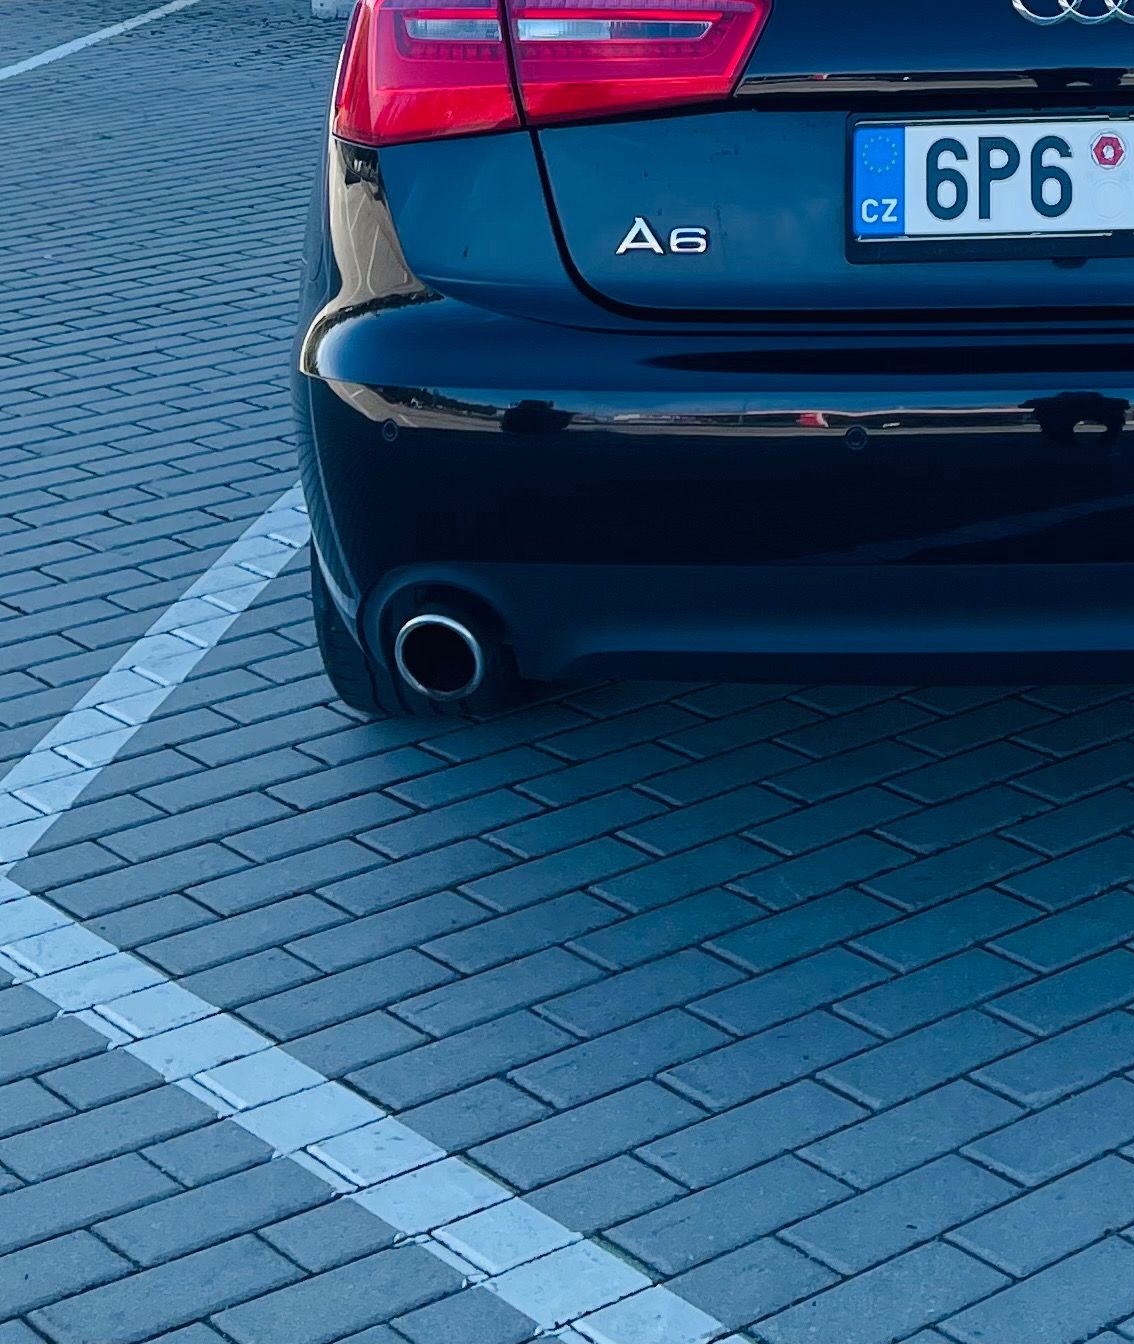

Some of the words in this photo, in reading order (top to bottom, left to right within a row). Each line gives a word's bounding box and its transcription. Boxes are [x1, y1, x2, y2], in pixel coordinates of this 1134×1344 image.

[925, 135, 1073, 221] 6P6
[861, 198, 898, 224] CZ
[615, 217, 707, 254] A6
